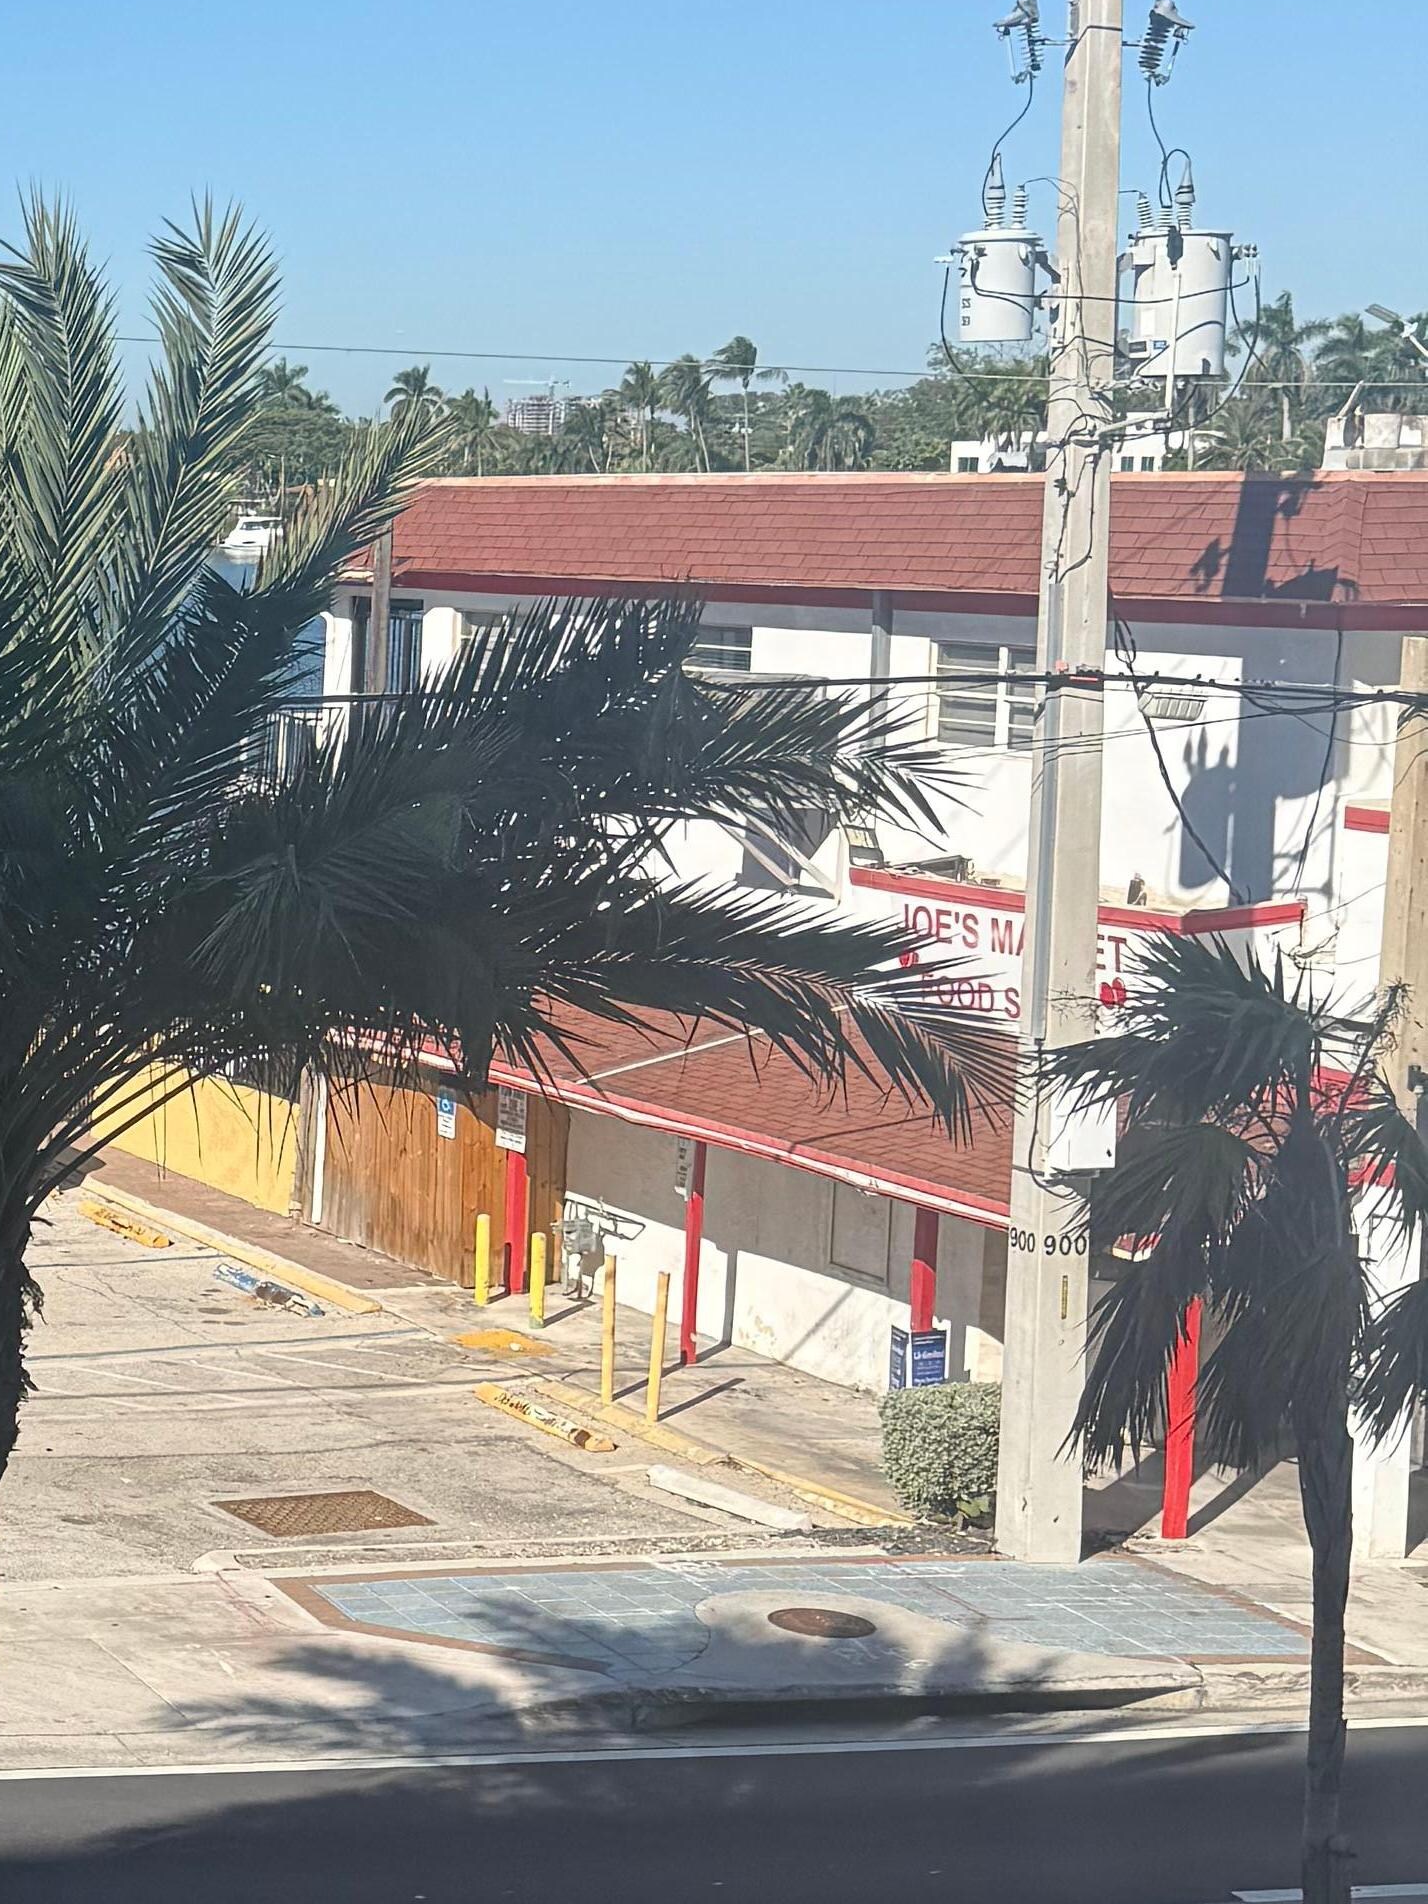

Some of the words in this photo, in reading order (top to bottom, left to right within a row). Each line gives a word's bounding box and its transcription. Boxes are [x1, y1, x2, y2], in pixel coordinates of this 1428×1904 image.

[903, 903, 980, 949] JOE'S
[1010, 1227, 1036, 1253] 900
[1044, 1235, 1087, 1256] 900
